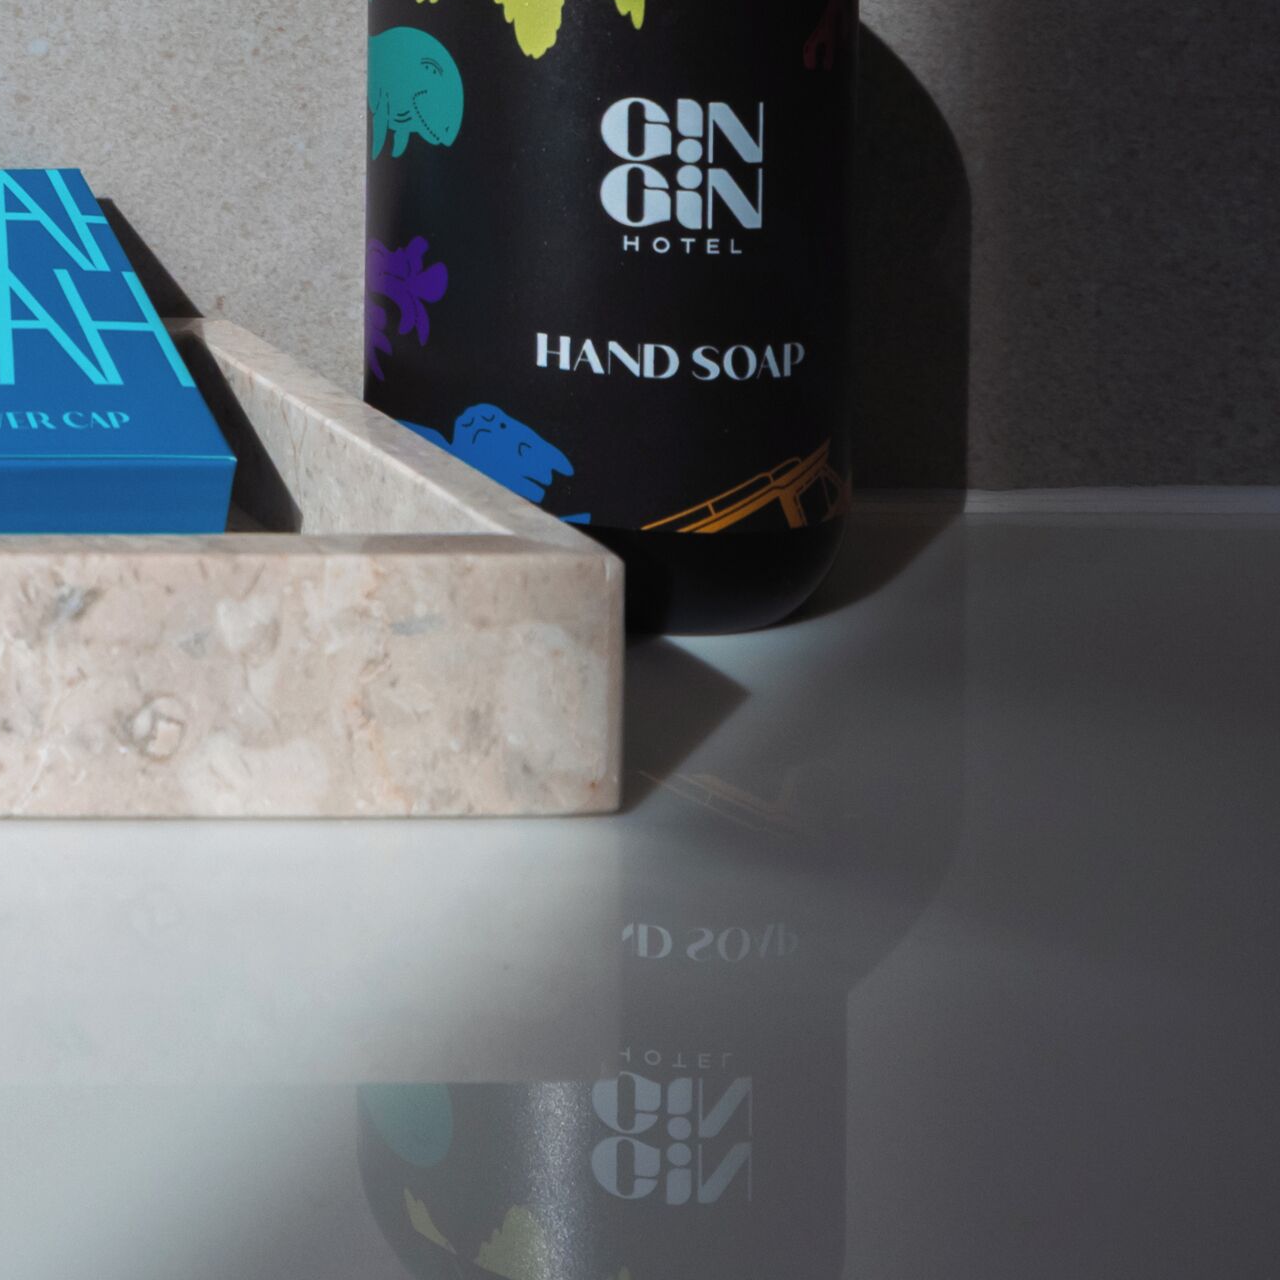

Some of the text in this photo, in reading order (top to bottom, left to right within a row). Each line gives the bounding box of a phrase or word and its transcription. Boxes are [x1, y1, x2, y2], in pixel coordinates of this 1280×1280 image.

[622, 234, 743, 255] HOTEL
[536, 332, 806, 382] HAND SOAP
[61, 410, 132, 431] CAP
